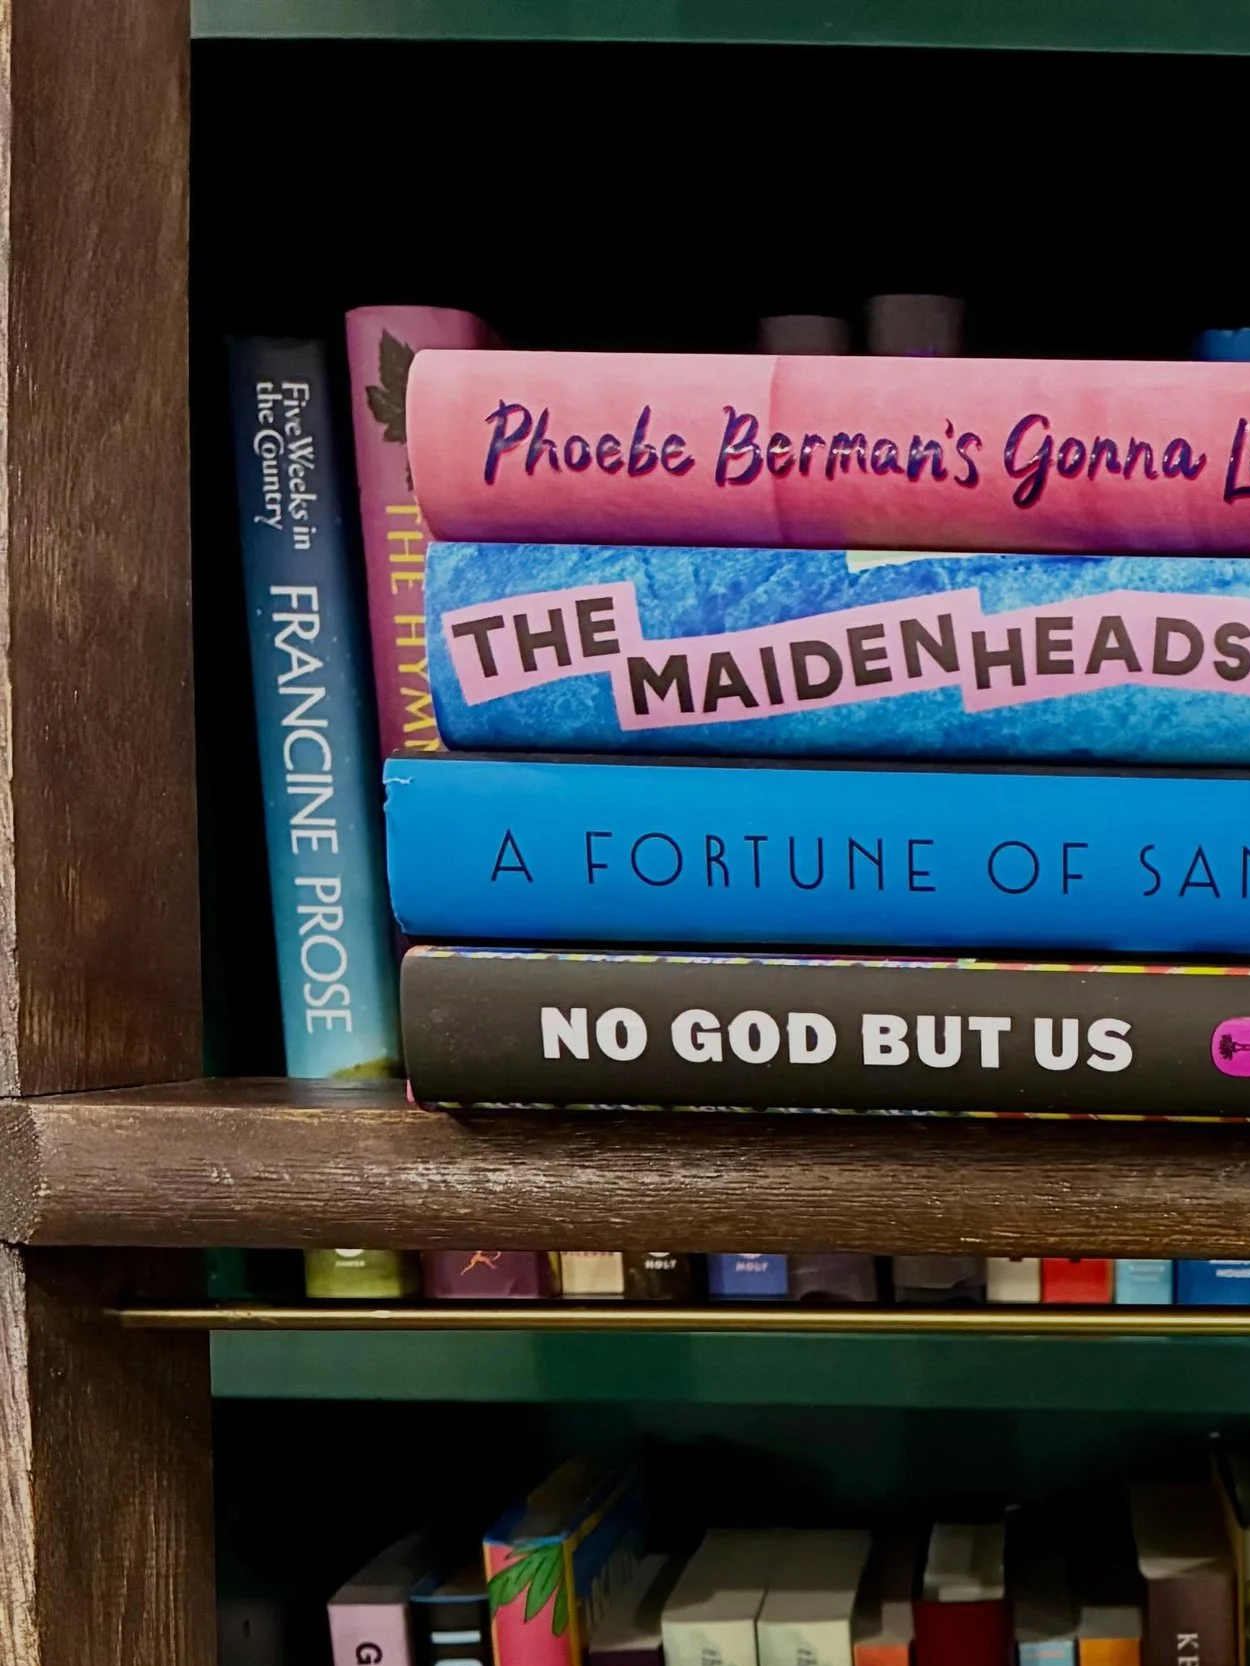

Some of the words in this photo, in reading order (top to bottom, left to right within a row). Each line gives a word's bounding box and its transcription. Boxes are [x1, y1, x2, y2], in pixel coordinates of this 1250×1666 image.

[256, 381, 282, 425] the
[282, 381, 310, 437] Five
[253, 428, 284, 531] Country
[287, 435, 317, 521] Weeks
[483, 399, 695, 486] Phoebe
[713, 404, 983, 488] Berman's
[1003, 413, 1207, 509] Gonna
[294, 526, 316, 551] in
[385, 505, 425, 595] THE
[451, 596, 622, 679] THE
[269, 585, 339, 855] FRANCINE
[490, 828, 534, 884] A
[585, 830, 937, 893] FORTUNE
[987, 840, 1089, 896] OF
[294, 877, 352, 1033] PROSE
[540, 1006, 648, 1062] NO
[670, 1008, 838, 1065] GOD
[861, 1013, 1012, 1070] BUT
[1033, 1017, 1134, 1073] US
[430, 1629, 482, 1645] I
